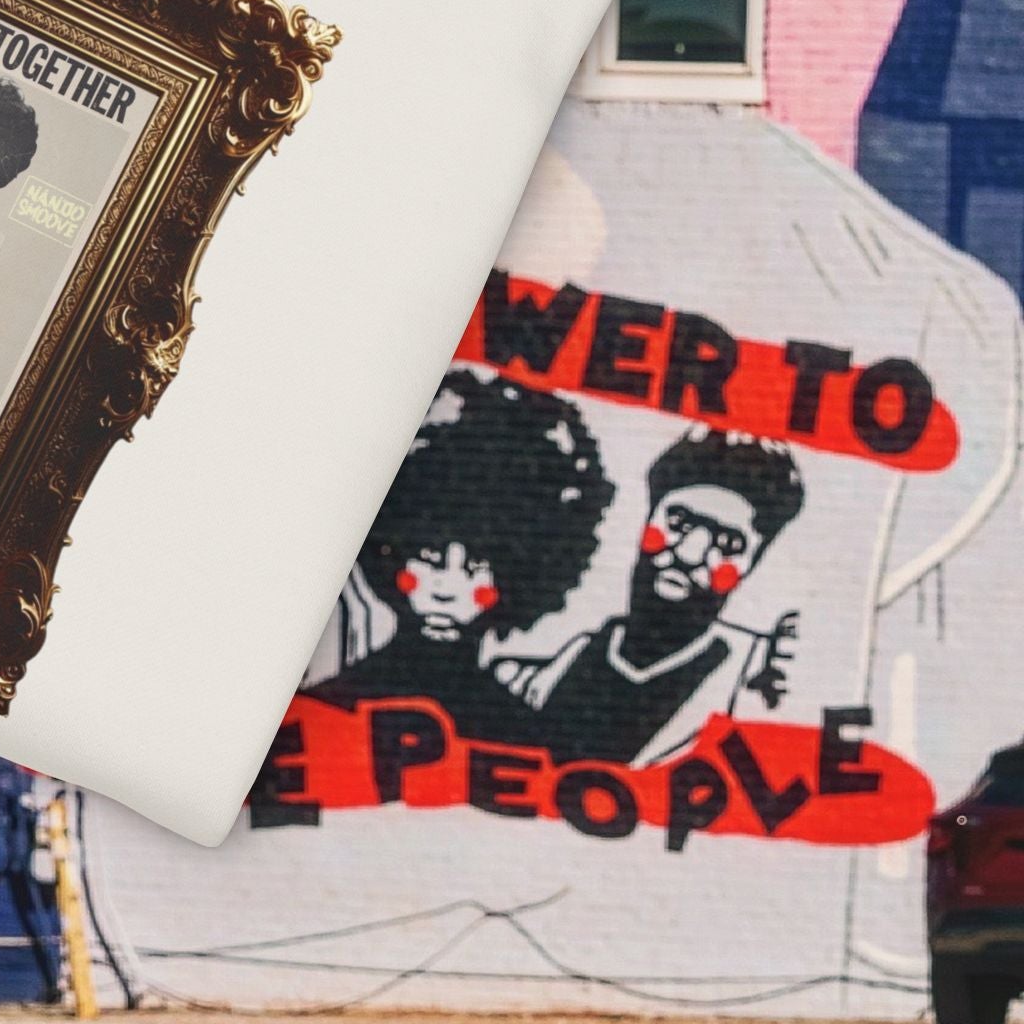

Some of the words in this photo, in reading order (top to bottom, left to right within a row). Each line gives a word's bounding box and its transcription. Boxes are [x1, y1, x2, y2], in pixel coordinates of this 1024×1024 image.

[18, 198, 78, 239] SMOOVE
[784, 340, 932, 455] TO
[370, 706, 882, 852] PEOPLE
